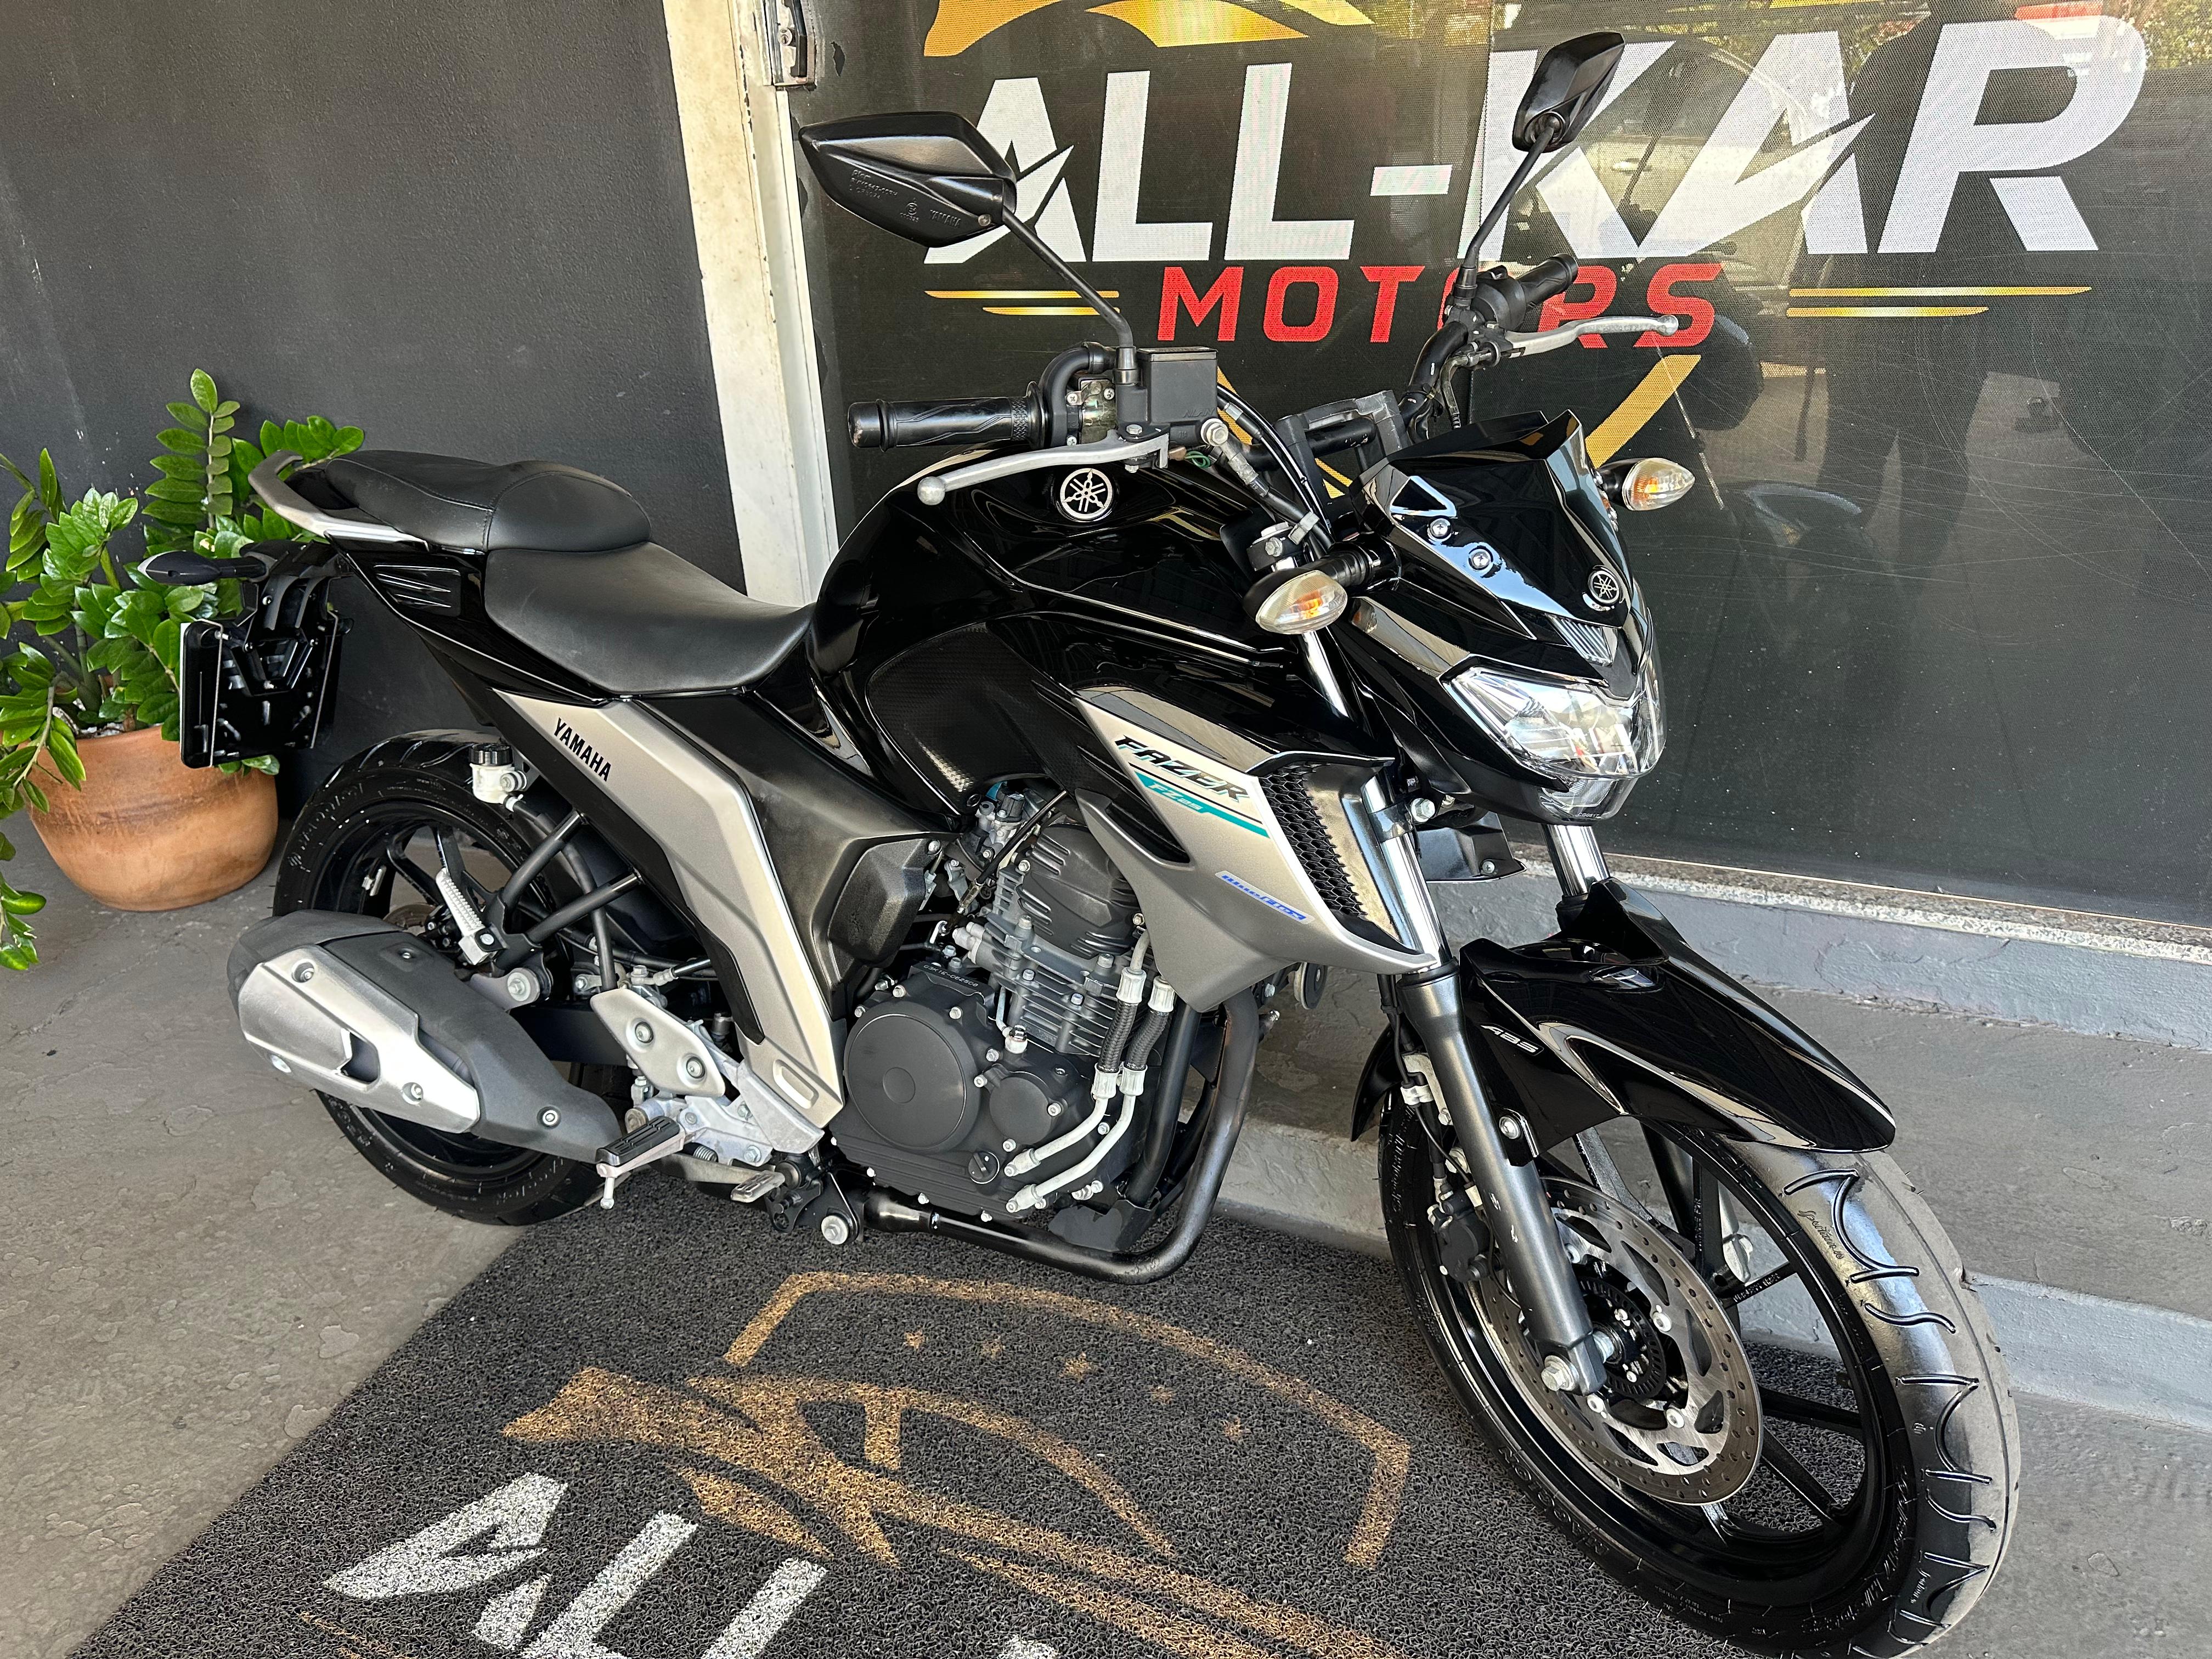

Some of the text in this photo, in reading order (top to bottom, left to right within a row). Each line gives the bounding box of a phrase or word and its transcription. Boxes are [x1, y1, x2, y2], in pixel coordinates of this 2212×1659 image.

[924, 15, 2146, 264] ALL-KAR
[1158, 263, 1723, 349] MOTRS
[553, 717, 612, 782] YAMAHA
[1115, 735, 1250, 803] FAZER
[1148, 782, 1203, 811] FZ25
[1480, 1025, 1539, 1053] ABS
